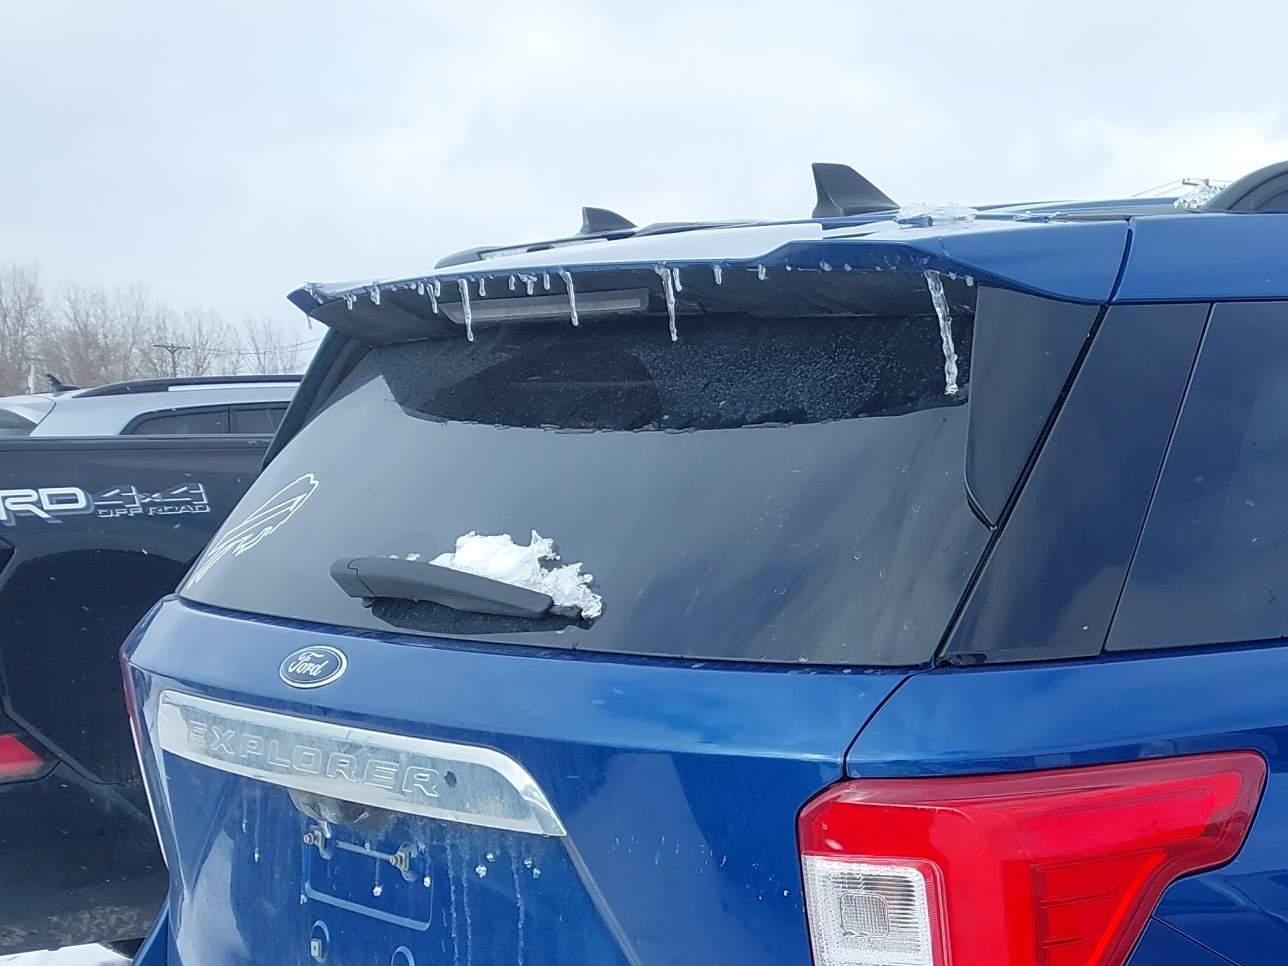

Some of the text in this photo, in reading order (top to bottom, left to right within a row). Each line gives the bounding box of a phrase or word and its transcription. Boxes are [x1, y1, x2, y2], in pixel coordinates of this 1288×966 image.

[97, 503, 211, 518] OFF ROAD
[287, 651, 330, 677] Ford
[187, 719, 440, 798] EXPLORER
